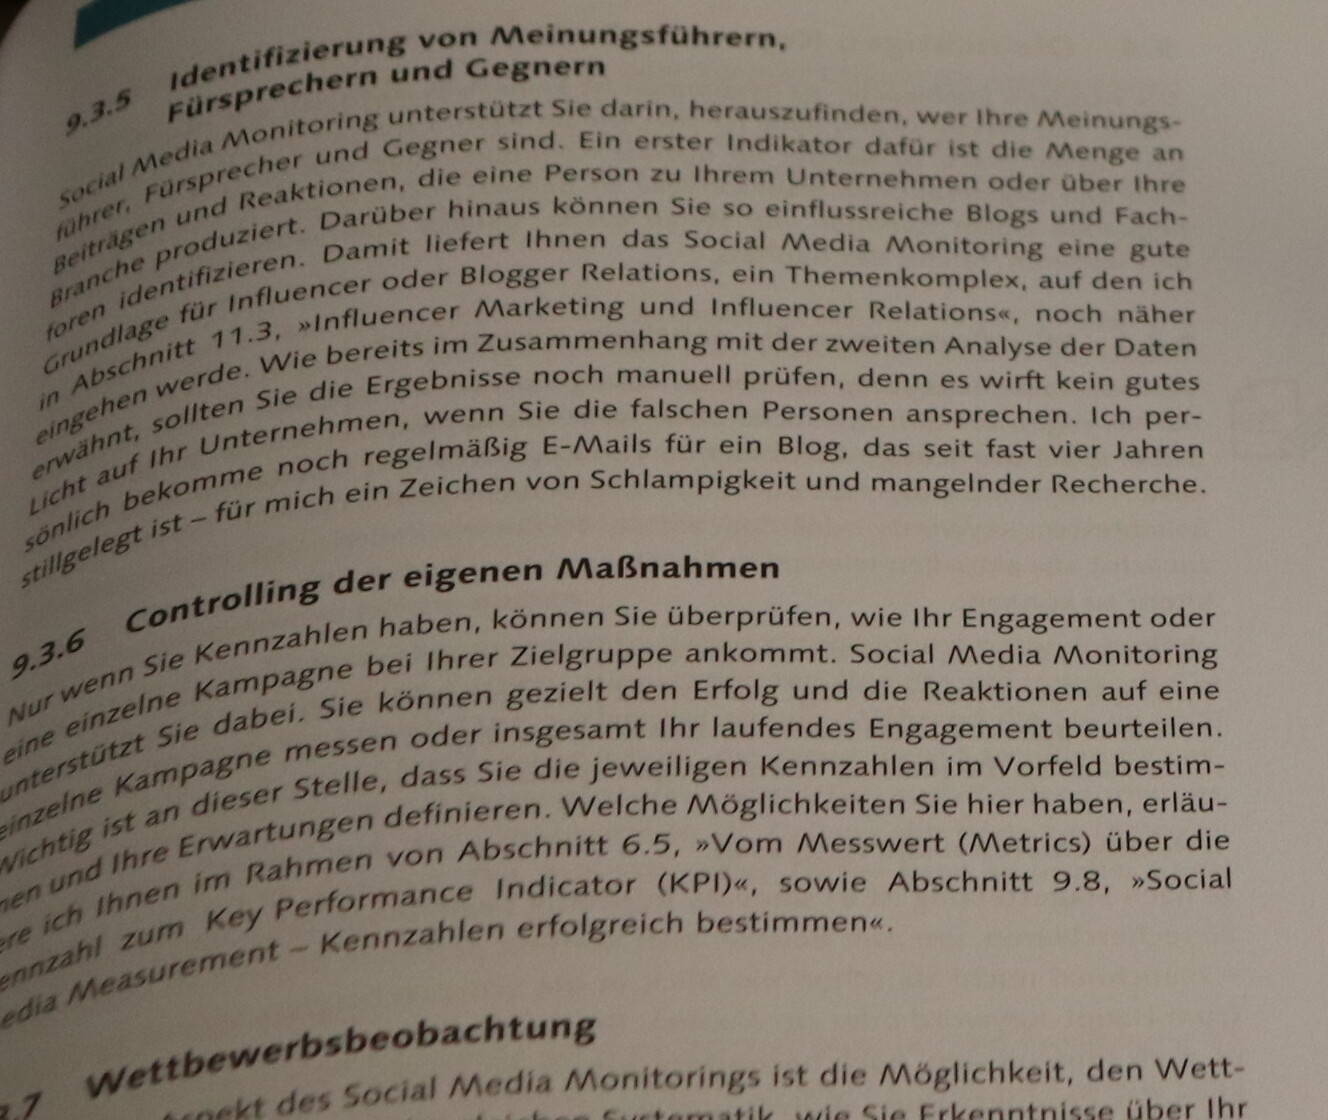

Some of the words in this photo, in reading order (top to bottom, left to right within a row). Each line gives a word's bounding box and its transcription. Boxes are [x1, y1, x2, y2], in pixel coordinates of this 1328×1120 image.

[65, 87, 131, 137] 9.3.5
[169, 35, 406, 91] Identifizierung
[417, 30, 477, 49] von
[489, 23, 786, 51] Meinungsführern,
[167, 69, 378, 123] Fürsprechern
[390, 57, 453, 84] und
[464, 56, 605, 83] Gegnern
[57, 162, 125, 208] Social
[132, 138, 215, 179] Media
[220, 111, 379, 150] Monitoring
[387, 99, 543, 126] unterstützt
[551, 98, 592, 118] Sie
[599, 97, 679, 121] darin,
[688, 98, 907, 126] herauszufinden,
[915, 110, 968, 126] wer
[975, 106, 1029, 127] Ihre
[1036, 109, 1180, 135] Meinungs-
[19, 524, 142, 589] stillgelegt
[151, 513, 182, 538] ist
[215, 499, 255, 523] für
[264, 485, 335, 514] mich
[344, 481, 389, 504] ein
[398, 472, 515, 499] Zeichen
[525, 474, 580, 491] von
[589, 467, 796, 496] Schlampigkeit
[805, 469, 860, 492] und
[870, 471, 1042, 499] mangelnder
[1050, 472, 1206, 494] Recherche.
[7, 692, 55, 727] Nur
[60, 665, 134, 702] wenn
[143, 652, 184, 677] Sie
[194, 621, 368, 664] Kennzahlen
[378, 612, 480, 638] haben,
[492, 607, 604, 630] können
[614, 604, 657, 626] Sie
[667, 603, 840, 632] überprüfen,
[849, 606, 902, 627] wie
[912, 605, 952, 627] Ihr
[961, 607, 1141, 635] Engagement
[1149, 605, 1216, 628] oder
[11, 626, 86, 681] 9.3.6
[125, 579, 321, 633] Controlling
[332, 568, 392, 595] der
[402, 562, 543, 593] eigenen
[555, 553, 779, 580] Maßnahmen
[86, 1014, 596, 1098] Wettbewerbsbeobachtung
